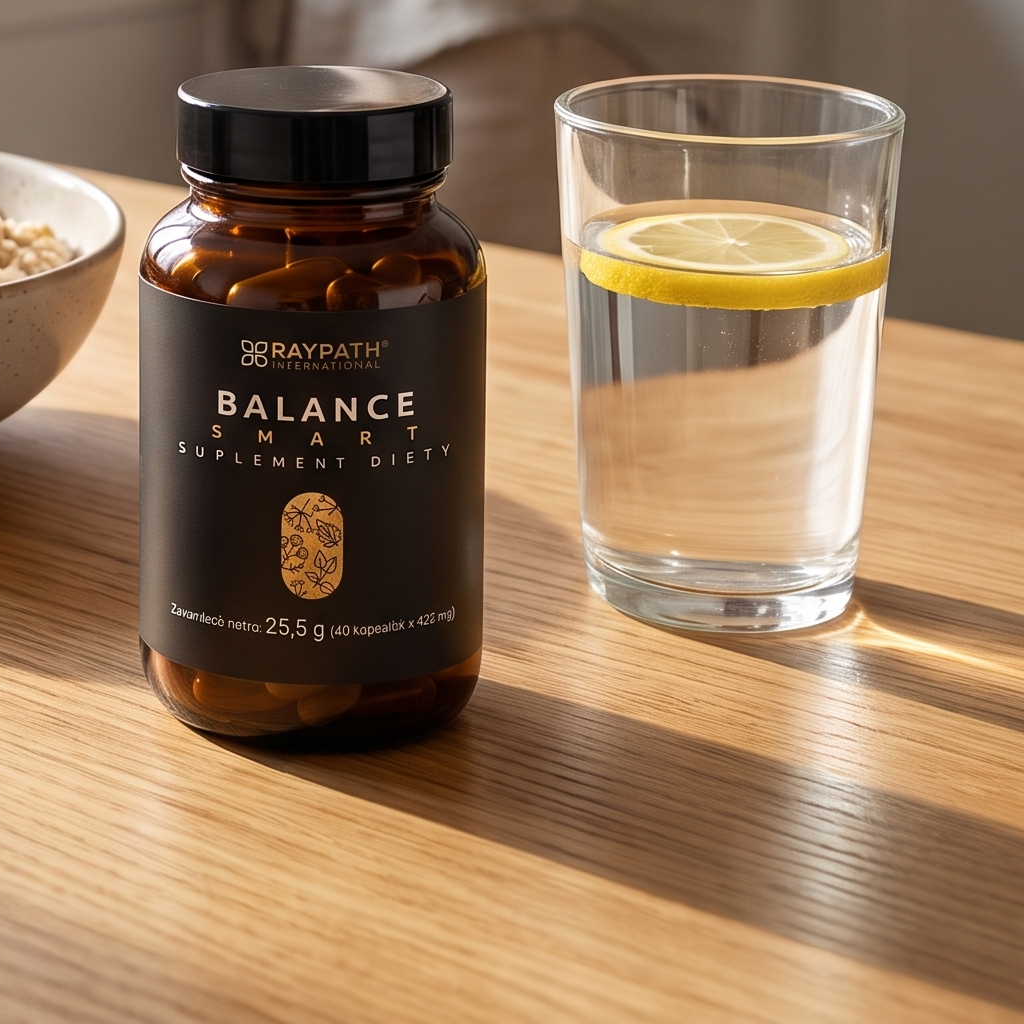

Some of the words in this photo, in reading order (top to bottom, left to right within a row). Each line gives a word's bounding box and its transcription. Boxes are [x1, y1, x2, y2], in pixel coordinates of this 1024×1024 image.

[217, 389, 415, 423] BALANCE
[178, 441, 345, 469] SUPLEMENT
[371, 443, 451, 468] DIETY
[265, 617, 308, 640] 25,5
[313, 622, 325, 642] g
[330, 624, 351, 639] (40
[408, 619, 415, 629] x
[437, 605, 456, 622] mg)
